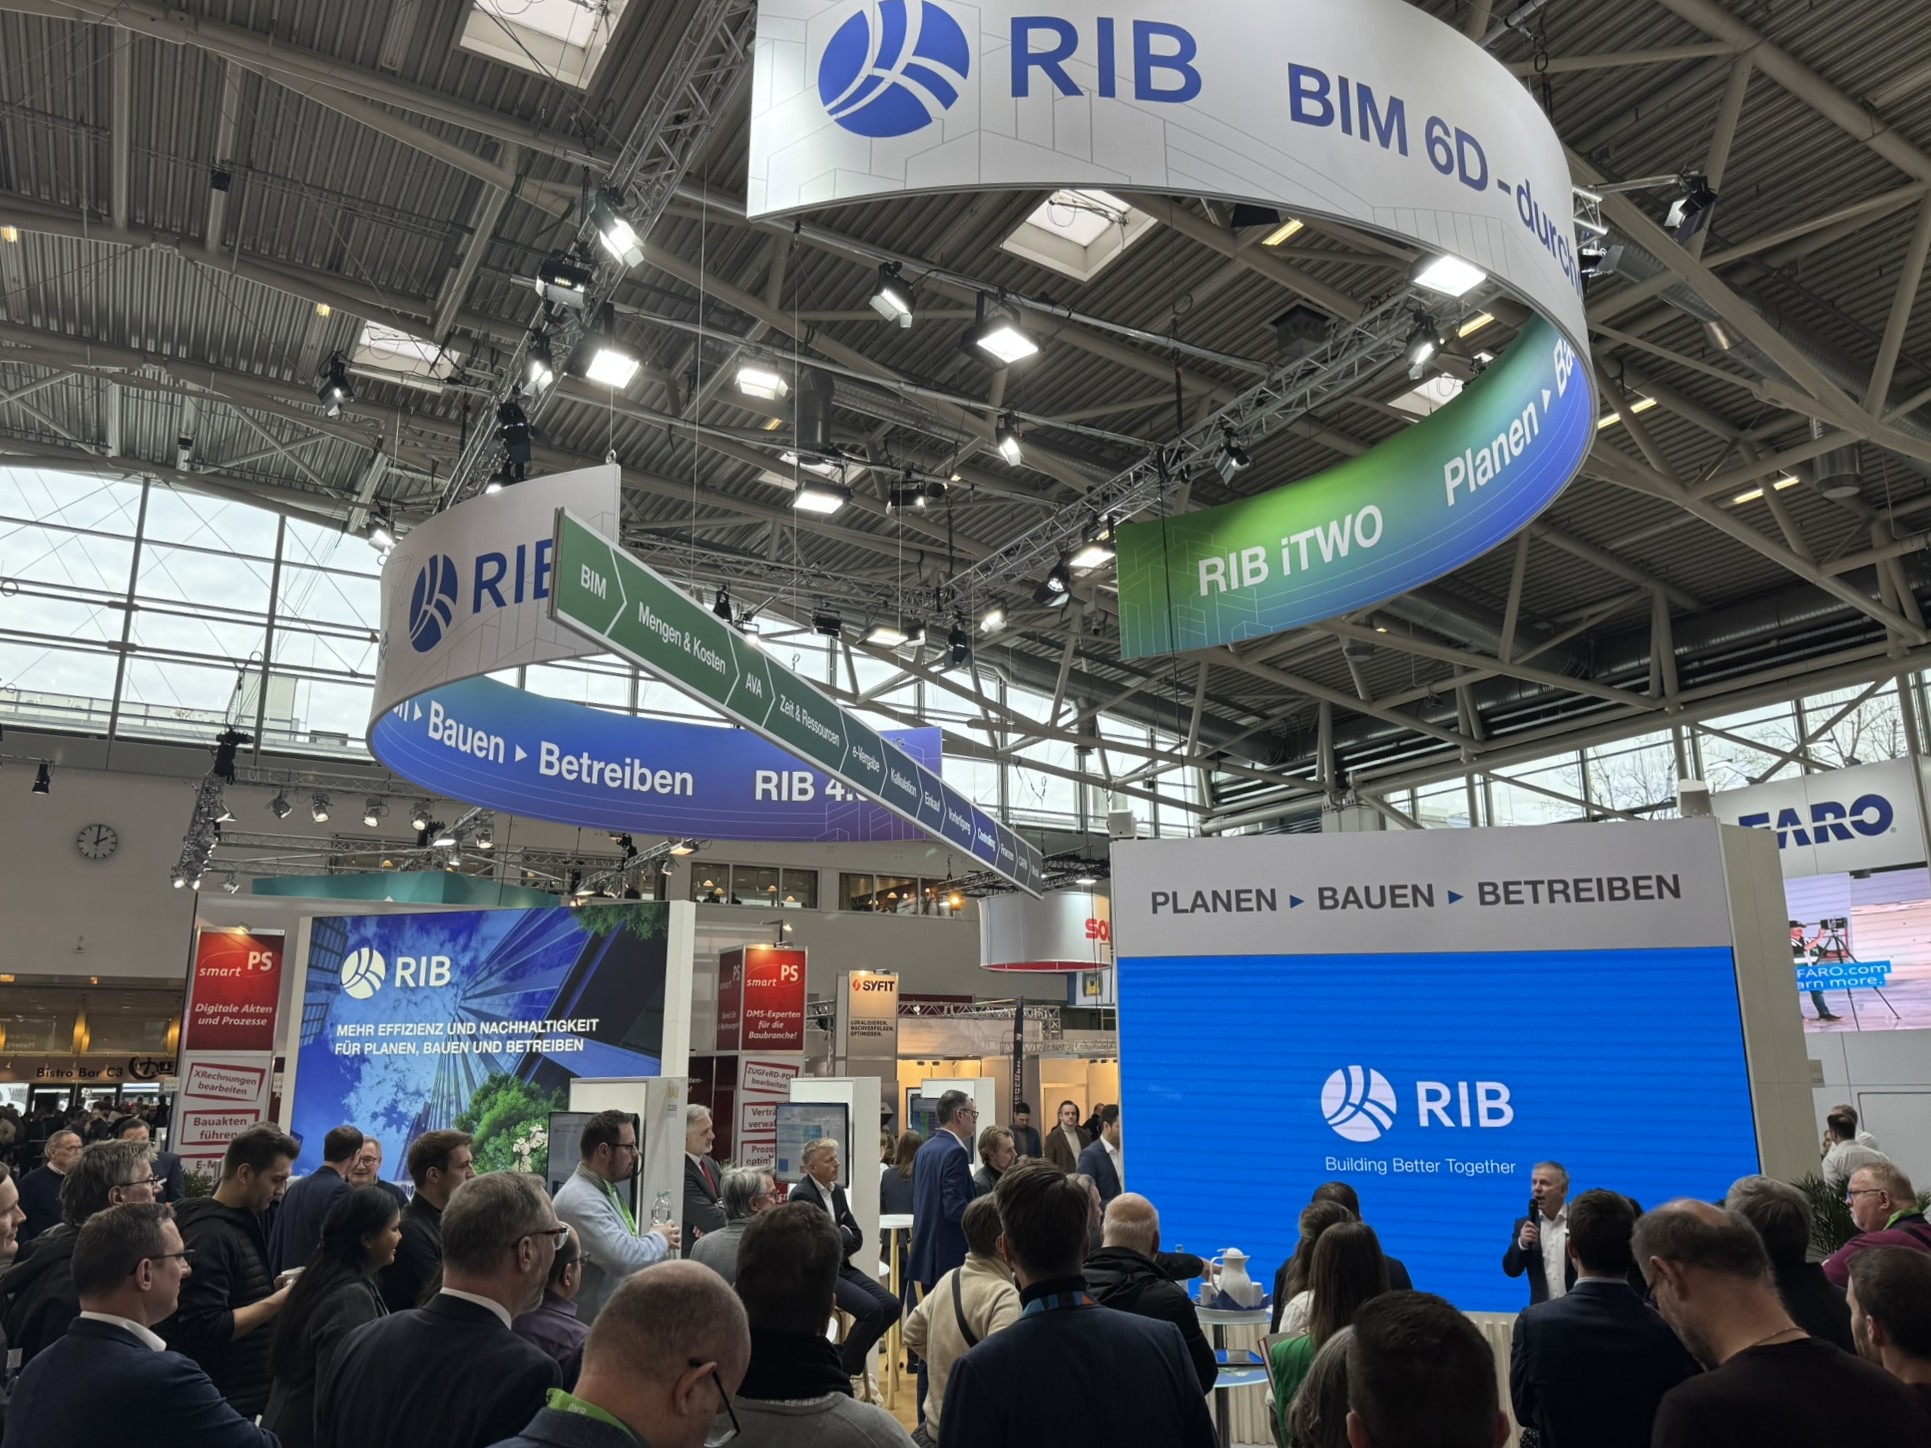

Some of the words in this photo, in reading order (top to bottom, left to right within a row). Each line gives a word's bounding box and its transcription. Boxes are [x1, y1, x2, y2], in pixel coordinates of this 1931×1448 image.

[1011, 16, 1202, 104] RIB
[1288, 62, 1406, 157] BIM
[1425, 115, 1488, 192] 6D
[1516, 178, 1586, 308] durch
[1443, 407, 1540, 507] Planen
[1553, 338, 1576, 398] Ba
[1198, 545, 1269, 597] RIB
[1281, 504, 1383, 576] iTWO
[580, 563, 607, 600] BIM
[638, 601, 682, 647] Mengen
[683, 631, 691, 653] &
[693, 637, 726, 675] Kosten
[745, 671, 763, 698] AVA
[779, 694, 795, 719] Zeit
[795, 704, 801, 722] &
[801, 709, 840, 747] Ressourcen
[428, 699, 505, 764] Bauen
[538, 740, 694, 796] Betreiben
[754, 769, 816, 801] RIB
[825, 777, 868, 802] 4.
[852, 744, 880, 772] e-Vergabe
[1151, 887, 1278, 915] PLANEN
[1317, 883, 1435, 911] BAUEN
[1477, 873, 1682, 907] BETREIBEN
[1085, 917, 1111, 942] SO
[198, 966, 242, 978] smart
[247, 951, 273, 972] PS
[395, 954, 452, 989] RIB
[1796, 963, 1888, 979] FARO.com
[746, 978, 777, 987] smart
[780, 964, 799, 982] PS
[1797, 980, 1824, 990] arn
[1830, 975, 1883, 987] more.
[862, 980, 895, 992] SYFIT
[195, 1003, 239, 1016] Digitale
[241, 1003, 273, 1015] Akten
[746, 1009, 801, 1018] DMS-Experten
[198, 1016, 220, 1026] und
[222, 1016, 268, 1026] Prozesse
[337, 1023, 375, 1037] MEHR
[378, 1023, 444, 1037] EFFIZIENZ
[447, 1022, 477, 1036] UND
[480, 1018, 600, 1035] NACHHALTIGKEIT
[758, 1020, 769, 1030] für
[771, 1021, 784, 1029] die
[748, 1031, 798, 1040] Baubranche!
[335, 1040, 361, 1056] FÜR
[364, 1042, 420, 1057] PLANEN,
[423, 1041, 468, 1055] BAUEN
[473, 1040, 503, 1054] UND
[506, 1038, 585, 1053] BETREIBEN
[36, 1067, 74, 1078] Bistro
[78, 1067, 101, 1078] Bar
[106, 1067, 123, 1078] C3
[193, 1070, 257, 1086] XRechnungen
[198, 1082, 248, 1095] bearbeiten
[751, 1077, 788, 1089] bearbeiten
[1416, 1080, 1514, 1129] RIB
[193, 1116, 247, 1126] Bauakten
[200, 1130, 238, 1140] führen
[751, 1145, 777, 1154] Proze
[196, 1160, 217, 1170] E-M
[746, 1156, 771, 1167] optim
[1325, 1156, 1388, 1176] Building
[1392, 1156, 1441, 1174] Better
[1445, 1157, 1516, 1178] Together
